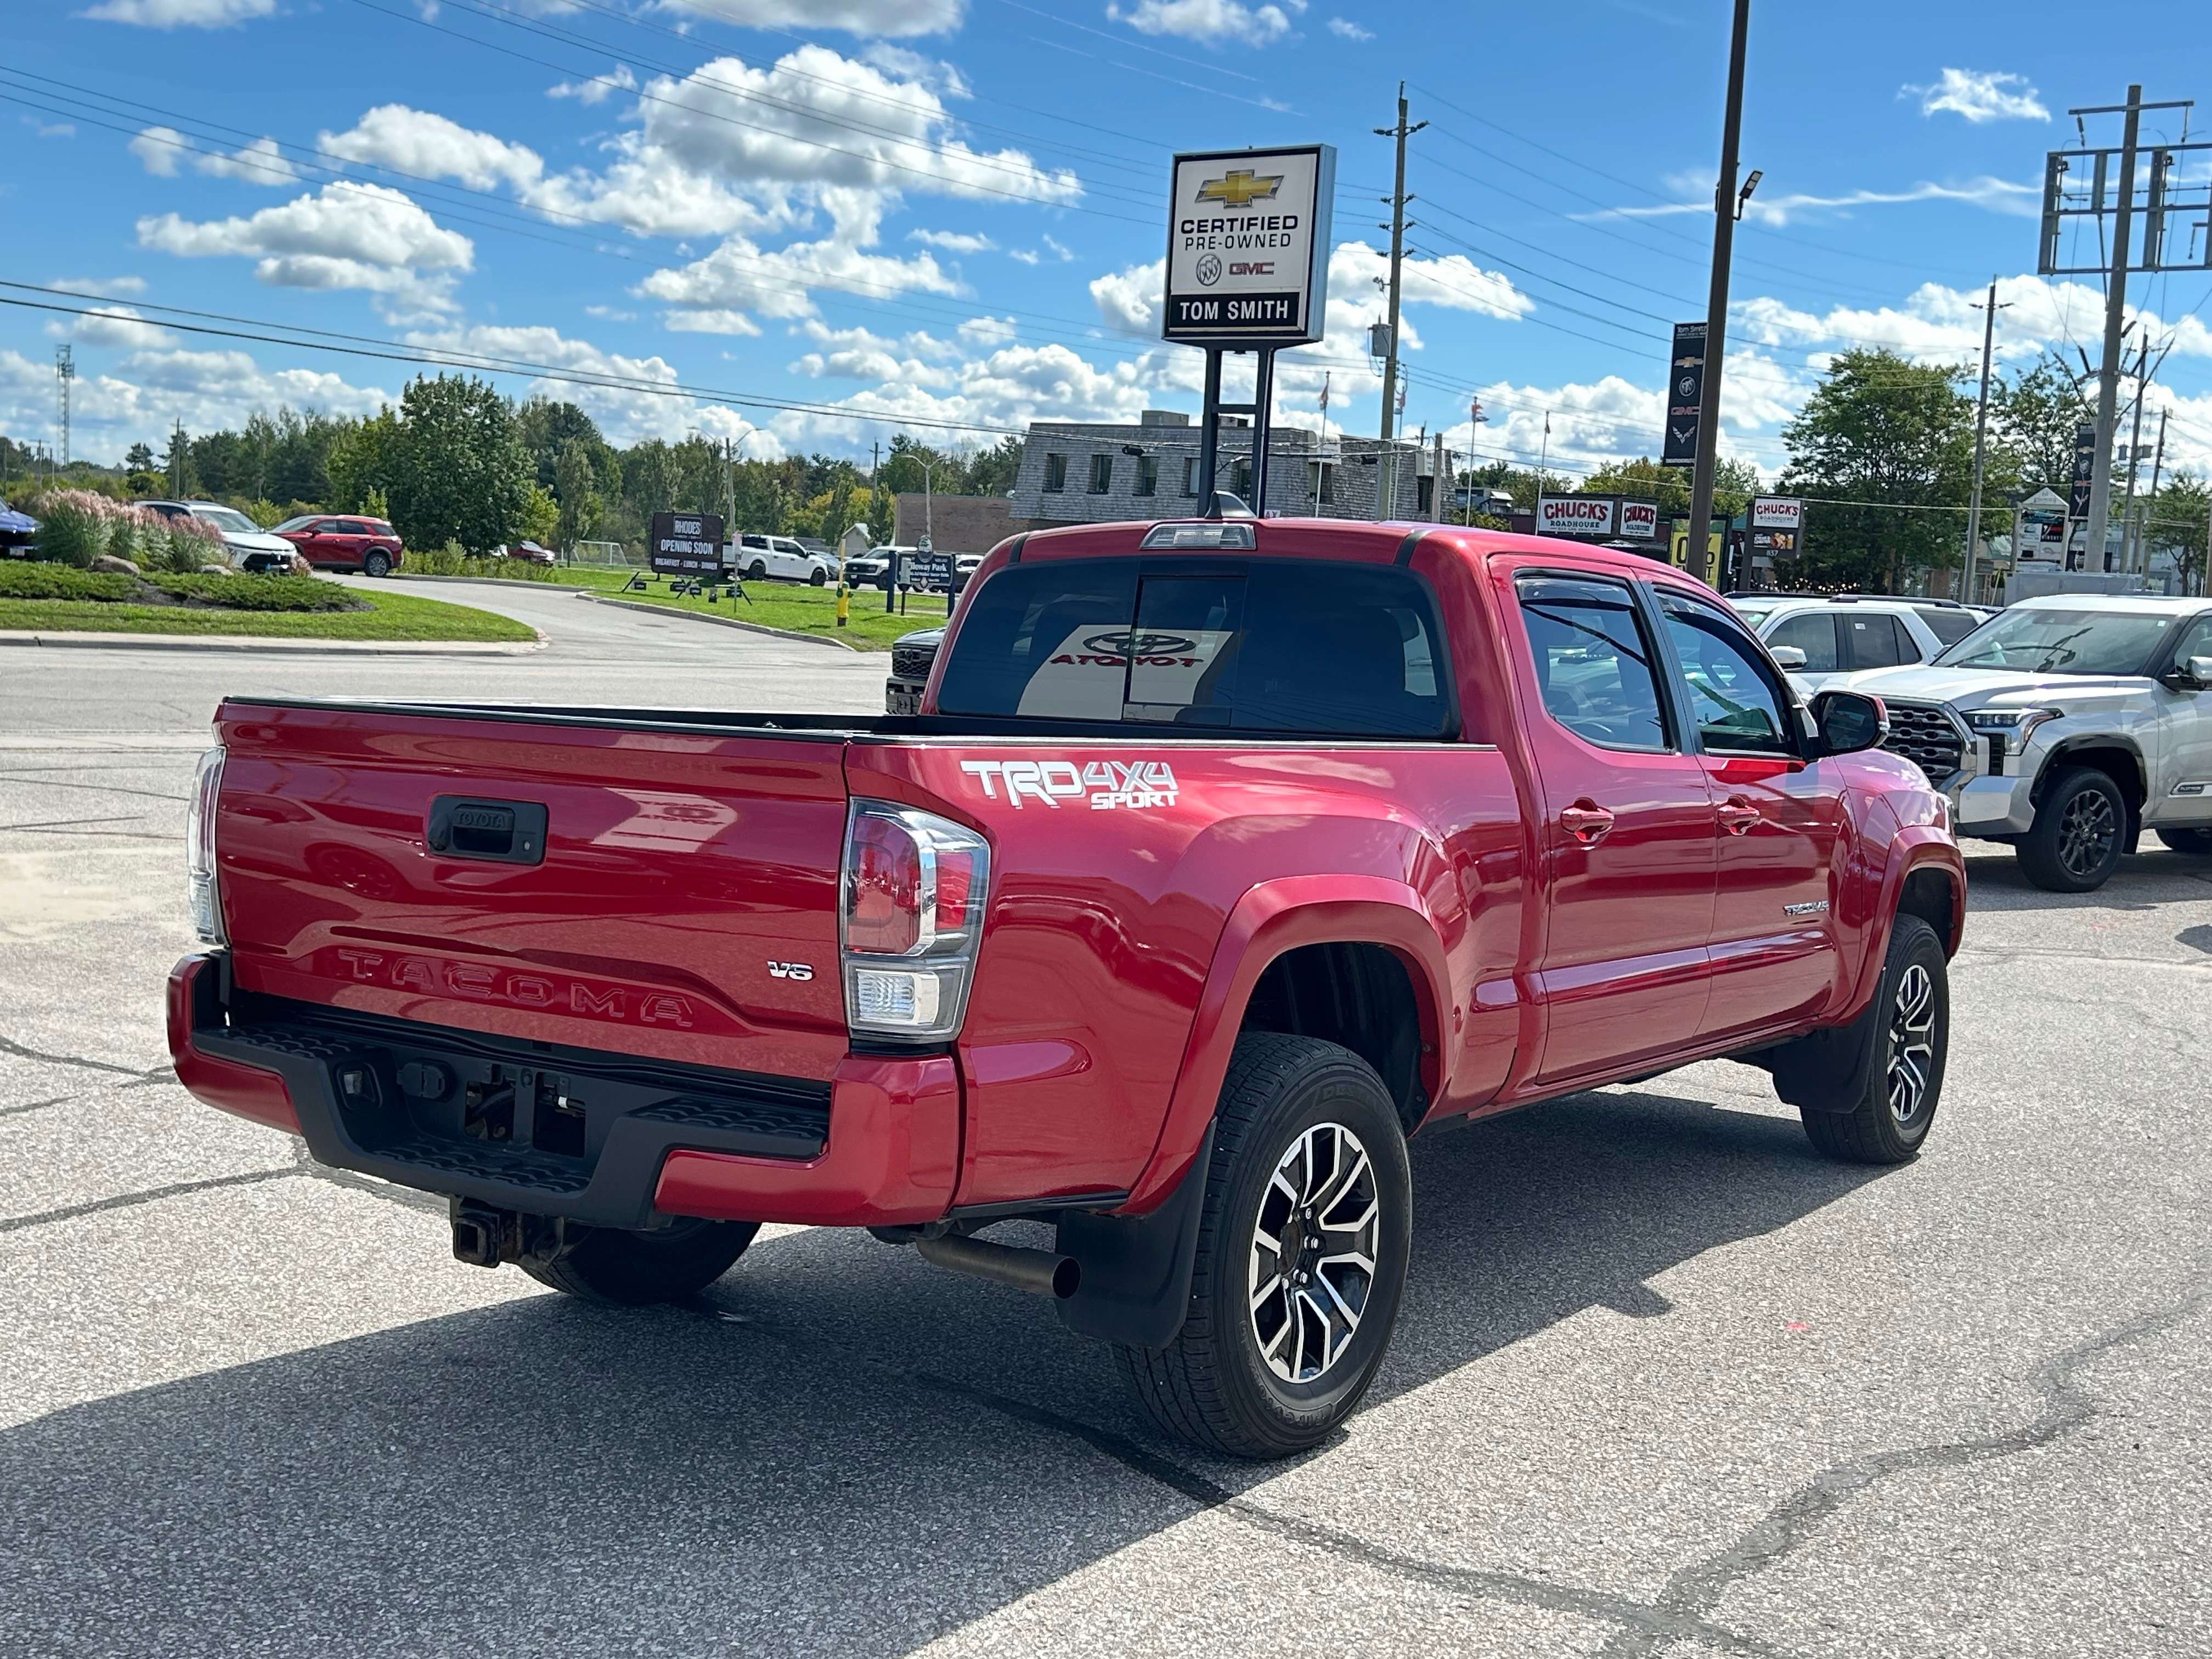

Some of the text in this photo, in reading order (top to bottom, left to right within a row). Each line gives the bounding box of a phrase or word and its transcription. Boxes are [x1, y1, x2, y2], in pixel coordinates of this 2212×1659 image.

[1181, 215, 1299, 234] CERTIFIED
[1185, 234, 1291, 251] PRE-OWNED
[1229, 262, 1274, 275] GMC
[1180, 300, 1288, 320] TOM SMITH
[1544, 502, 1608, 521] CHUCK'S
[1624, 505, 1655, 524] CHUCK'S
[1757, 504, 1798, 516] CHUCK'S
[675, 520, 701, 535] RHODES
[661, 539, 713, 555] OPENING SOON
[932, 563, 947, 572] Park
[960, 761, 1086, 809] TRD
[1091, 791, 1179, 810] SPORT
[456, 810, 505, 828] TOYOTA
[767, 960, 813, 981] V6
[338, 949, 693, 1028] TACOMA
